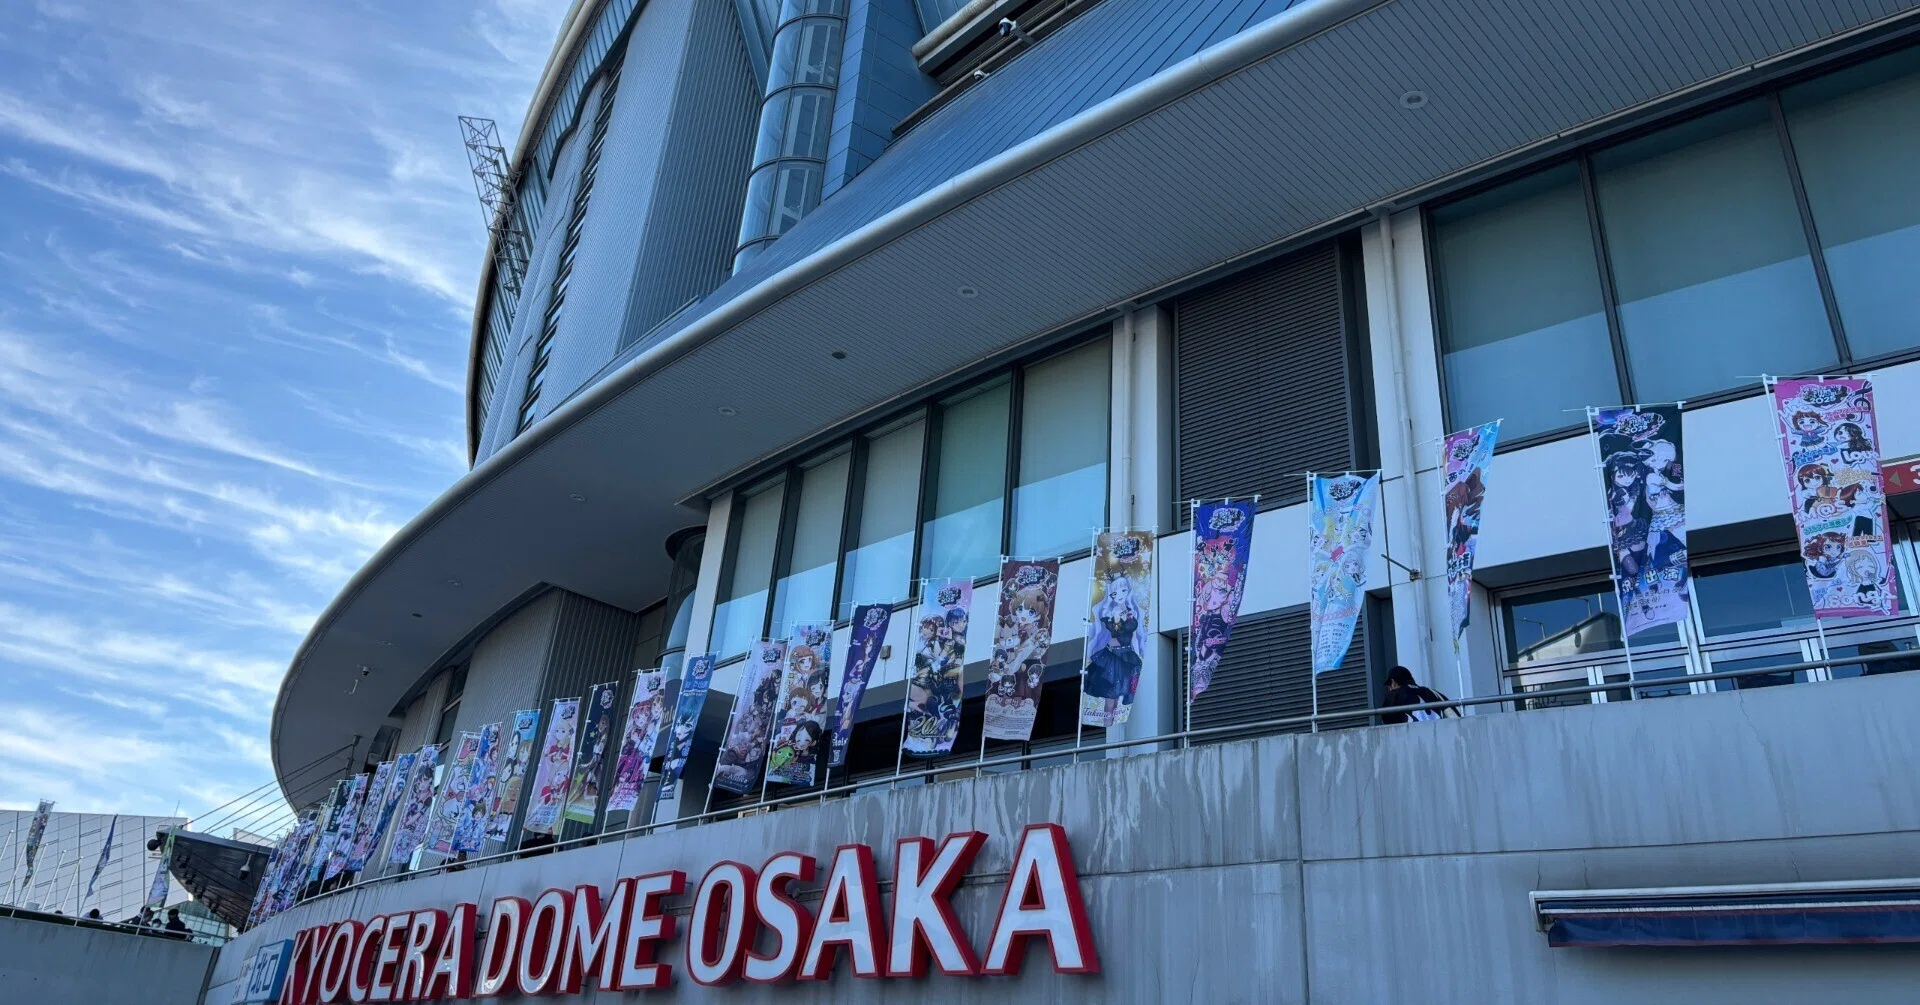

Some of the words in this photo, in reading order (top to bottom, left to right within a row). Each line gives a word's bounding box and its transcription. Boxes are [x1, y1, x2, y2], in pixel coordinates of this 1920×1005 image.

[279, 903, 477, 1005] KYOCERA
[473, 870, 687, 996] DOME
[686, 822, 1100, 987] OSAKA
